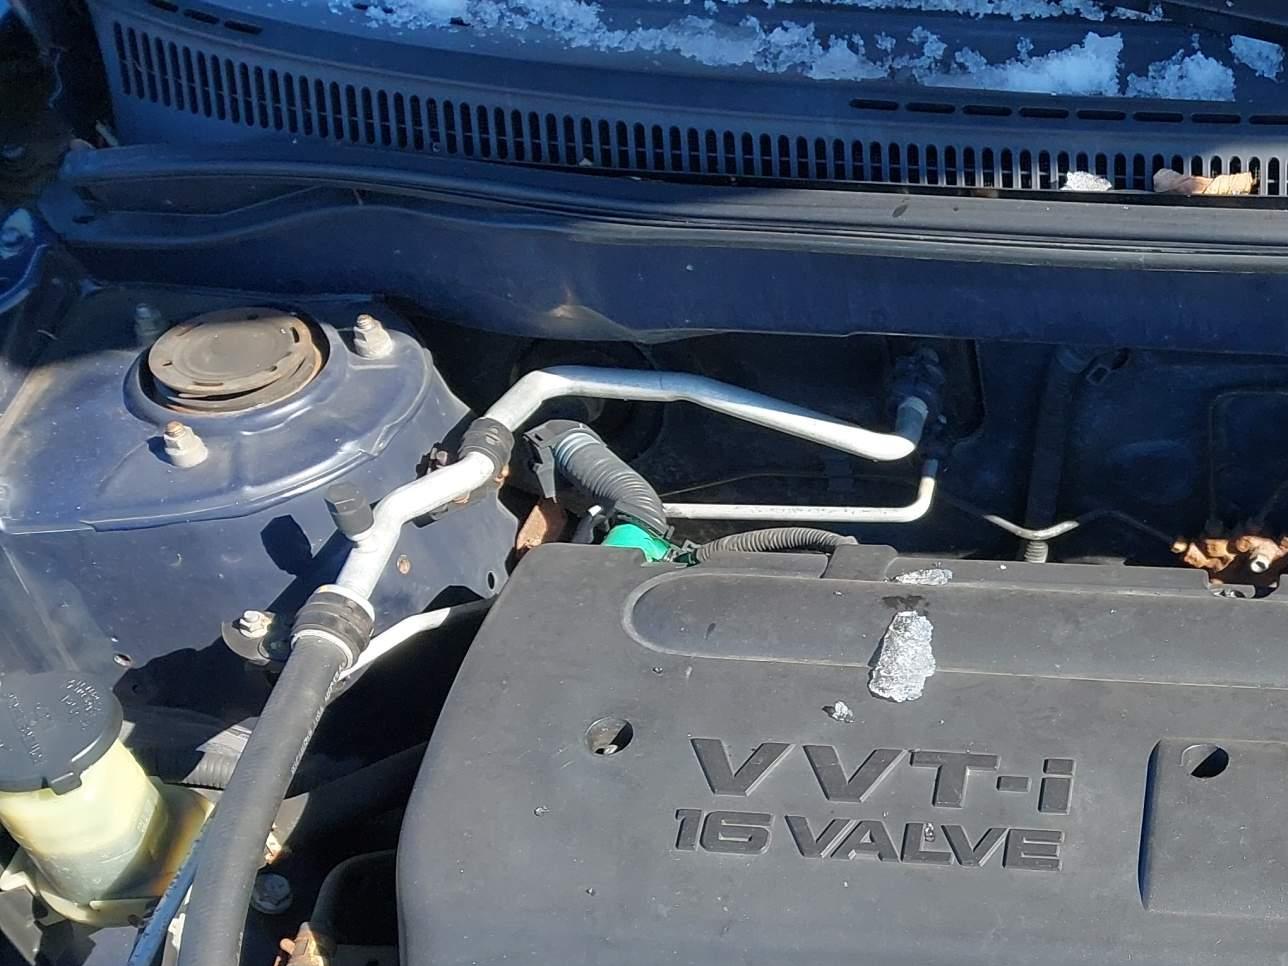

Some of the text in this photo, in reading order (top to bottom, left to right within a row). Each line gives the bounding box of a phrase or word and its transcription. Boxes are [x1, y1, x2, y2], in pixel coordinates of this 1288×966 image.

[690, 737, 1077, 814] VVT-i
[673, 808, 1065, 871] 16 VALVE
